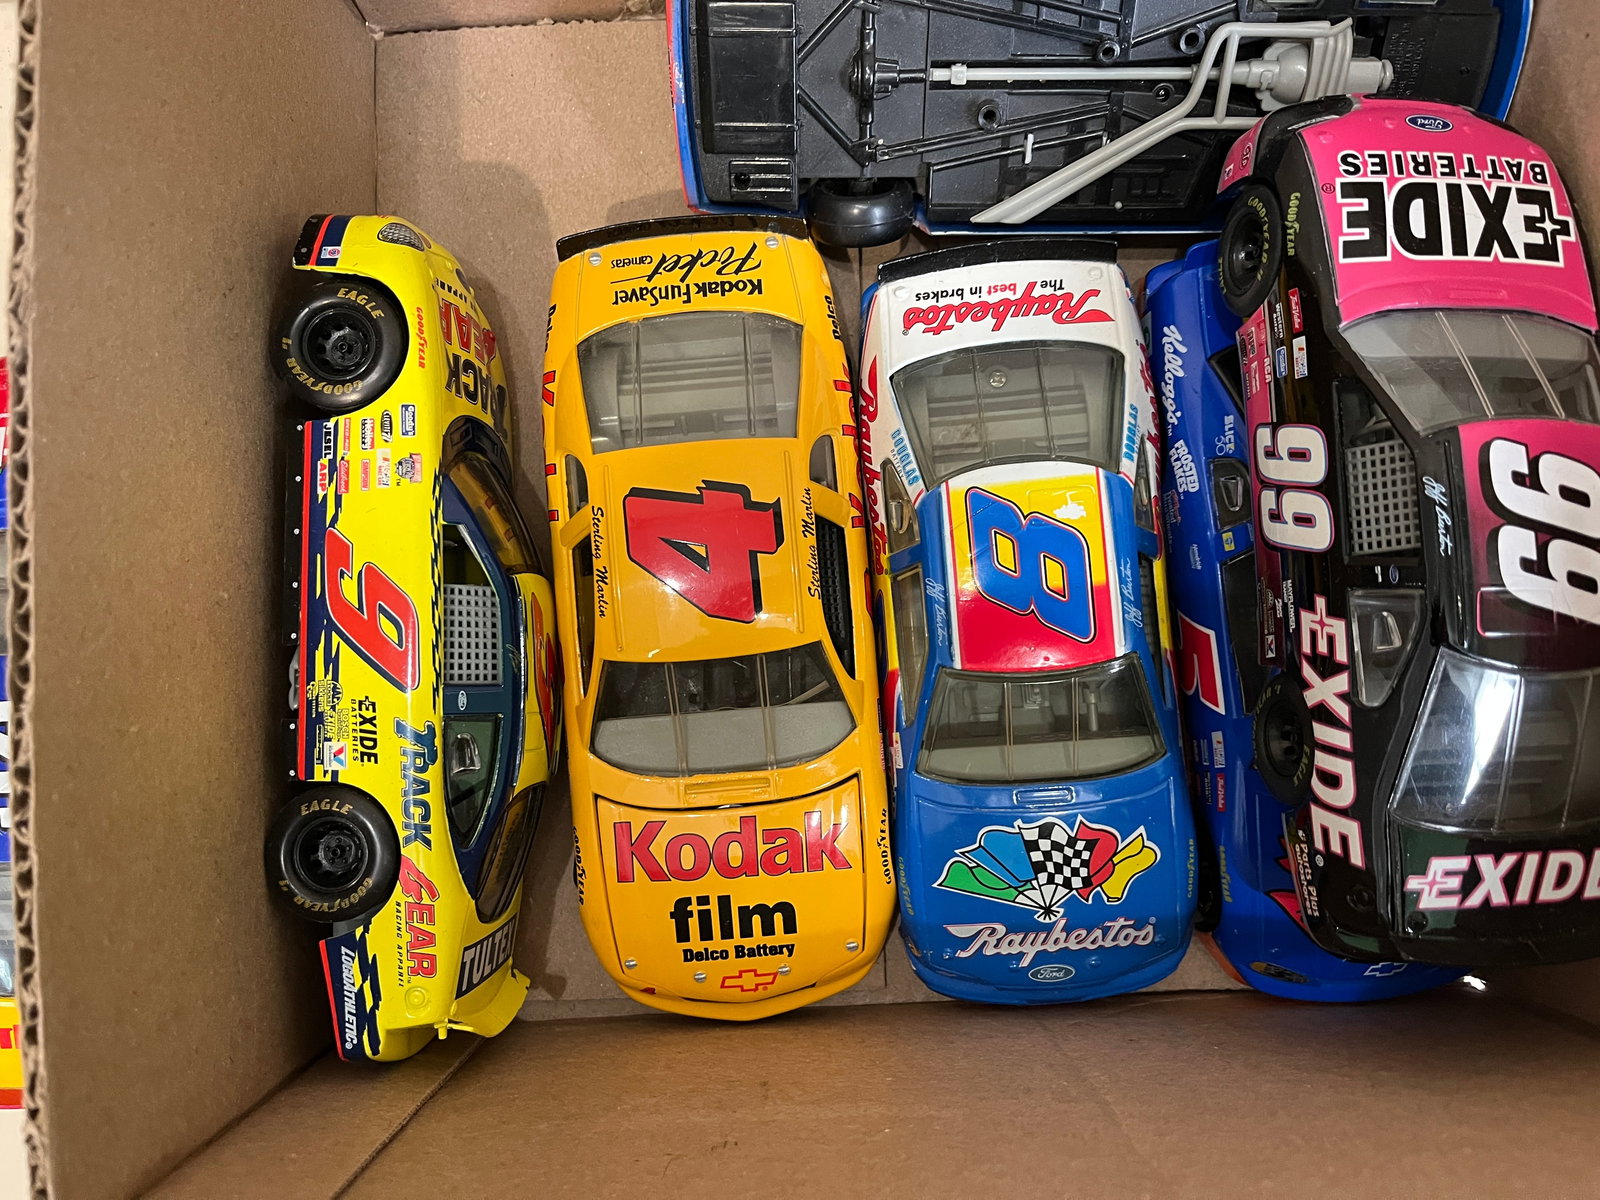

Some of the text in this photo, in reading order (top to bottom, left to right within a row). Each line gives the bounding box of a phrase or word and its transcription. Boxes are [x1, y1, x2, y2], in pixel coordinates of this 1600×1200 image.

[1416, 117, 1443, 130] Ford
[1337, 150, 1549, 185] BATTERIES
[1287, 192, 1301, 257] GOODYEAR
[1336, 177, 1575, 268] EXIDE
[611, 241, 762, 283] Pocket cameras
[612, 278, 763, 306] Kodak FunSaver
[915, 278, 1064, 302] The best in brakes
[337, 287, 385, 319] EAGLE
[903, 281, 1116, 336] Raybestos
[415, 306, 428, 369] GOODYEAR
[286, 357, 364, 396] GOODYEAR
[1162, 324, 1188, 431] Kellogg's
[323, 423, 332, 459] JESEL
[889, 429, 920, 486] DOUGLAS
[1123, 403, 1139, 463] DOUGLAS
[319, 463, 327, 492] ARP
[1169, 447, 1188, 498] FLAKES
[1174, 439, 1200, 493] FROSTED
[1255, 423, 1334, 552] 99
[802, 487, 817, 538] Marlin
[592, 505, 610, 618] Sterling Marlin
[623, 480, 785, 624] 4
[965, 486, 1097, 644] 8
[325, 528, 419, 694] 9
[1288, 580, 1296, 630] MAYFLOWER
[326, 709, 336, 740] EXIDE
[351, 698, 359, 761] BATTERIES
[357, 695, 379, 765] EXIDE
[1299, 594, 1365, 870] EXIDE
[300, 798, 354, 816] EAGLE
[394, 717, 438, 851] TRACK
[613, 810, 852, 883] Kodak
[877, 808, 892, 886] GOODYEAR
[1187, 838, 1195, 898] GOODYEAR
[293, 877, 374, 913] GOODYEAR
[898, 856, 915, 916] GOODYEAR
[1296, 844, 1312, 916] autostores
[1301, 843, 1320, 917] Parts Plus
[395, 901, 404, 987] RACING APPAREL
[399, 854, 440, 978] GEAR
[669, 894, 798, 944] film
[943, 917, 1154, 968] Raybestos
[462, 920, 515, 992] TULTEX
[682, 943, 796, 963] Delco Battery
[1037, 968, 1066, 979] Ford
